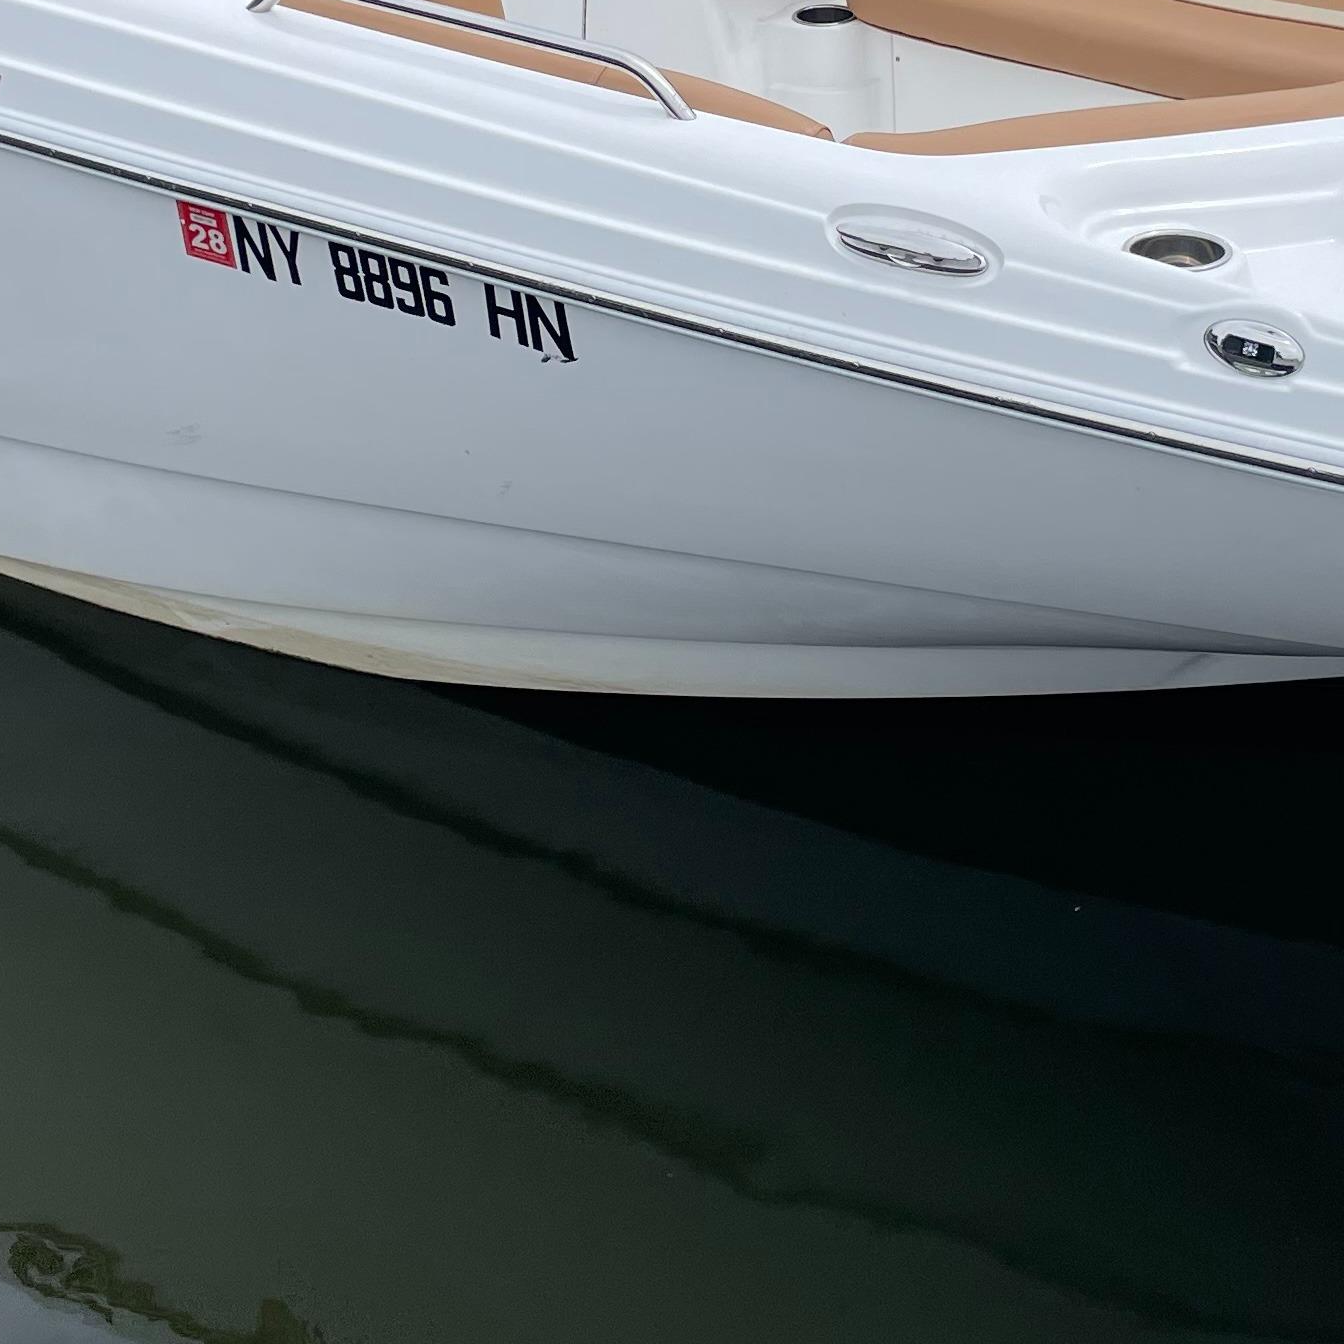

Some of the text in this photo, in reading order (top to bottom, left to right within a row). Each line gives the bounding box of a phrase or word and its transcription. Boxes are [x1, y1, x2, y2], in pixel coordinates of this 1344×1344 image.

[188, 223, 228, 256] 28
[232, 214, 579, 363] NY 8896 HN
